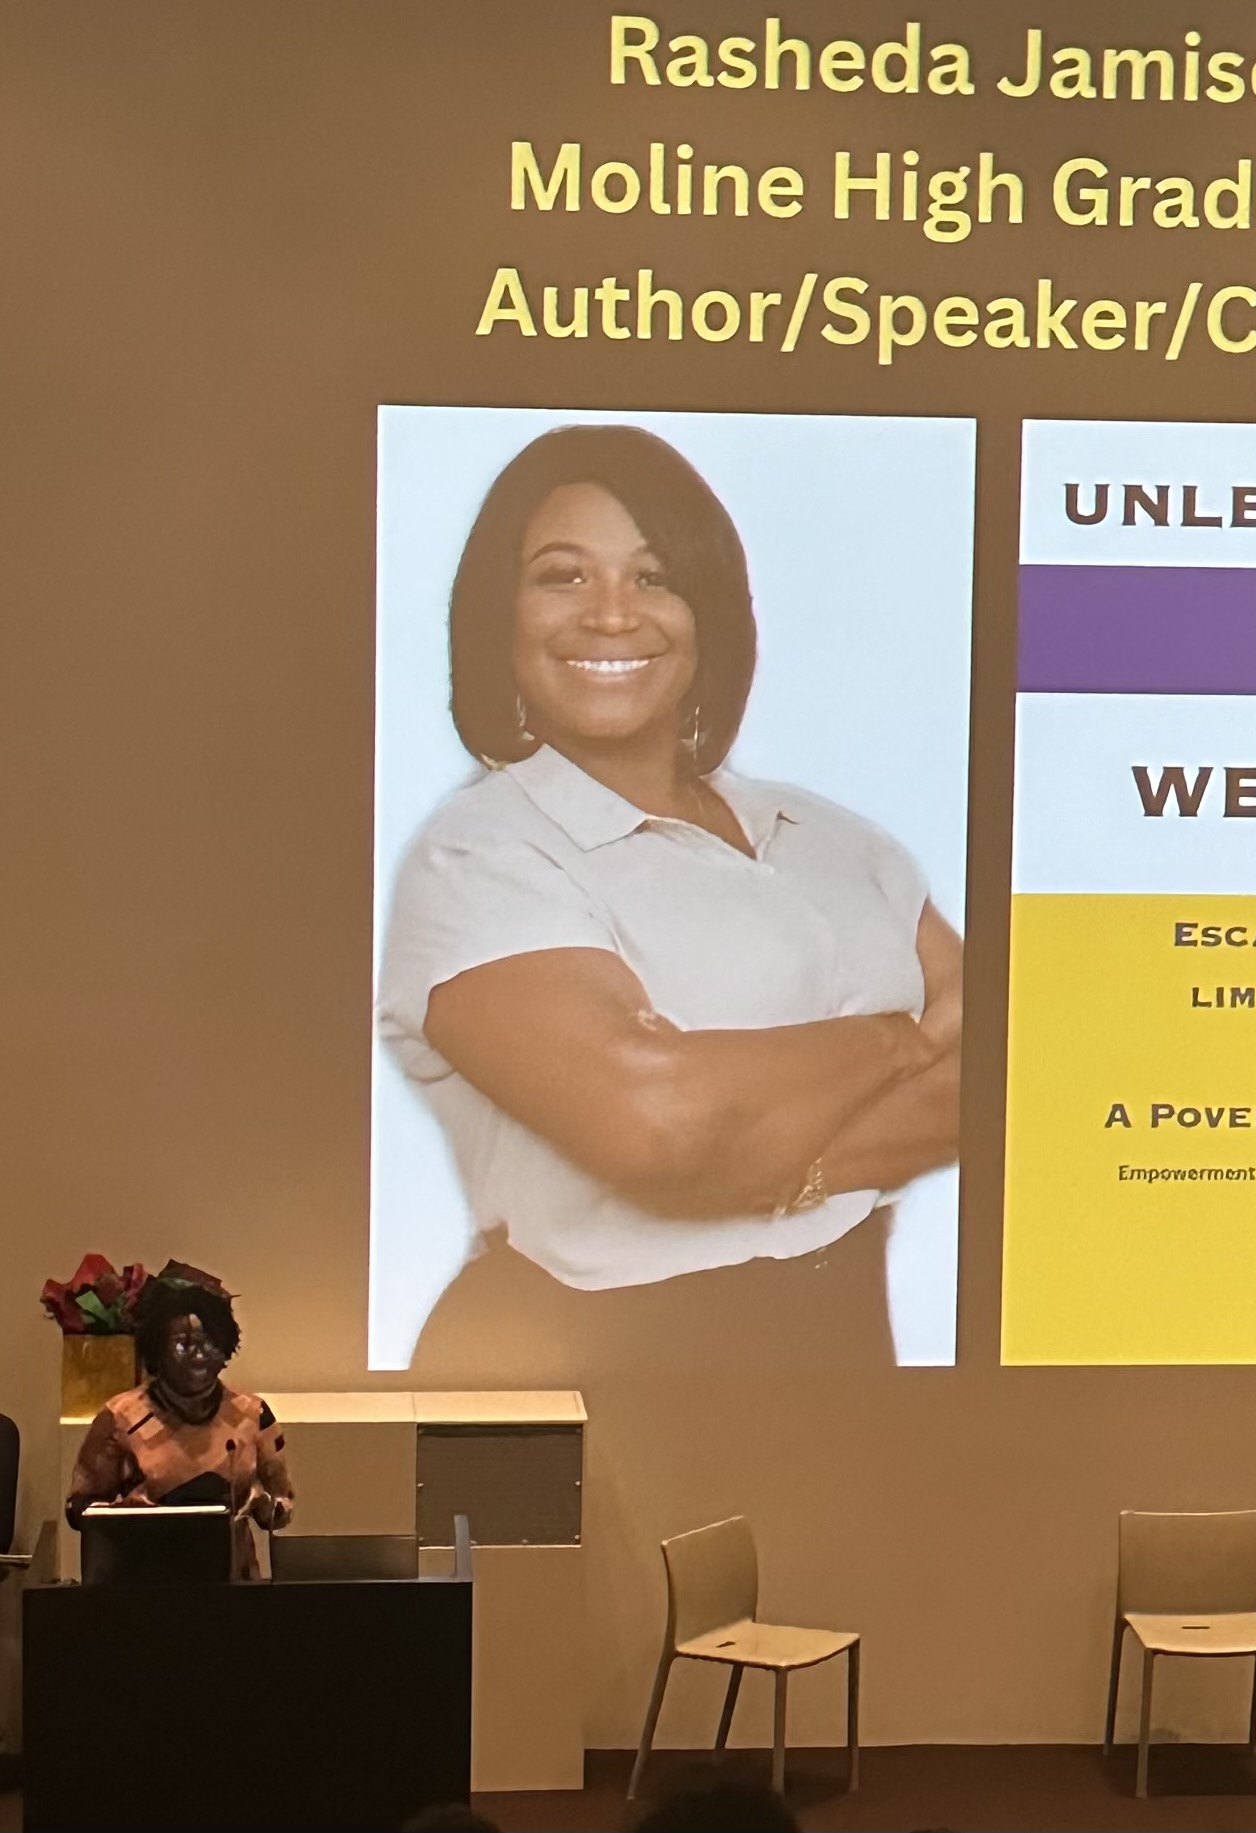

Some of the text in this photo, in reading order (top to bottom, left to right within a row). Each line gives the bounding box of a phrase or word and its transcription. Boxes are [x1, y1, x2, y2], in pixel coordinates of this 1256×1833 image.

[609, 16, 974, 96] Rasheda
[509, 142, 804, 219] Moline
[834, 151, 1023, 243] High
[1105, 1103, 1131, 1129] A
[1118, 1164, 1255, 1184] Empowerment
